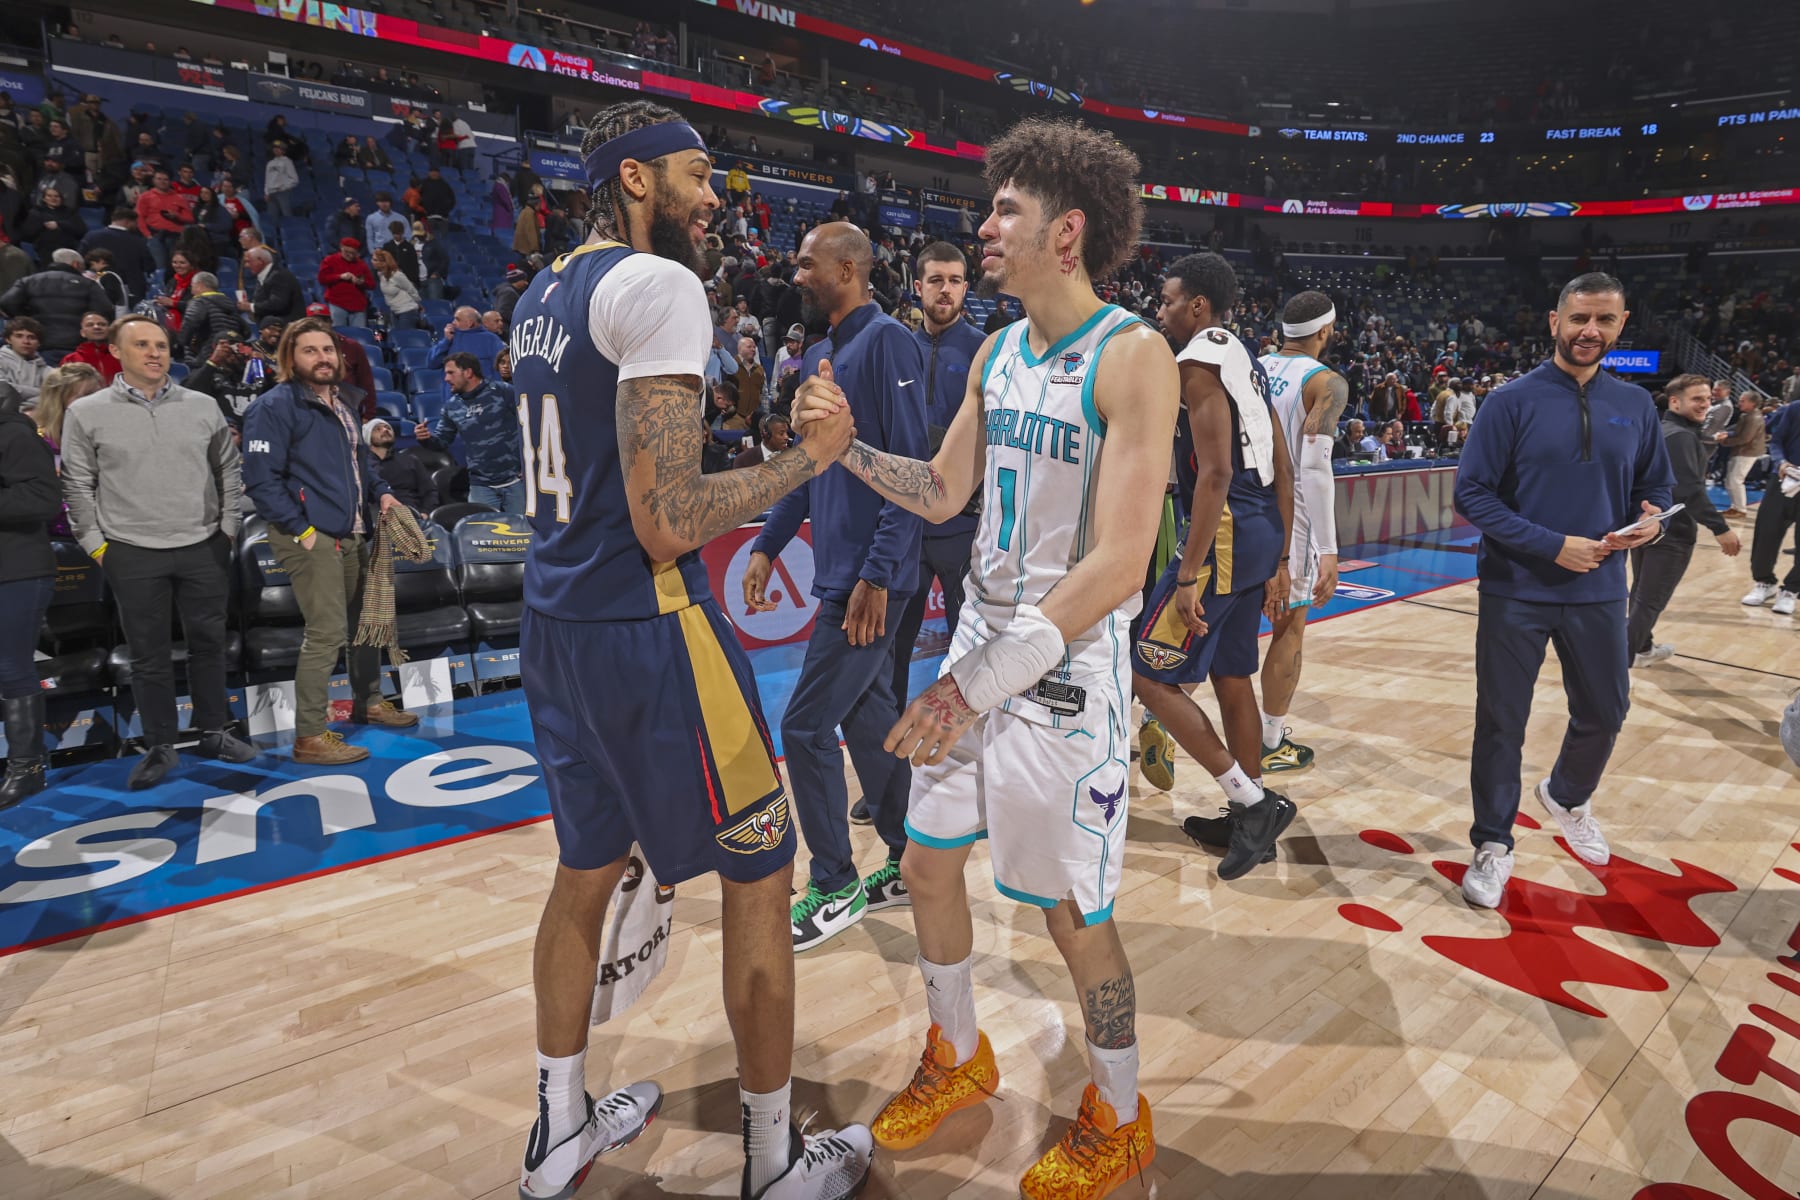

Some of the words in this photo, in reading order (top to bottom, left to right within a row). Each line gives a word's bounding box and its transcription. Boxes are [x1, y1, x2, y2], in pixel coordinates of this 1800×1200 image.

[253, 0, 378, 38] WIN!
[735, 0, 797, 28] WIN!
[553, 52, 588, 67] Aveda
[553, 64, 578, 77] Arts
[580, 70, 590, 80] &
[591, 71, 640, 90] Sciences
[299, 87, 340, 103] PELICANS
[340, 93, 365, 107] RADIO
[1717, 114, 1747, 127] PTS
[1749, 112, 1766, 124] IN
[1304, 129, 1332, 141] TEAM
[1333, 131, 1368, 142] STATS:
[1397, 134, 1417, 144] 2ND
[1418, 133, 1465, 144] CHANCE
[1480, 132, 1495, 143] 23
[1546, 129, 1576, 140] FAST
[1578, 126, 1622, 139] BREAK
[1641, 124, 1658, 135] 18
[762, 164, 834, 184] BETRIVERS
[1599, 356, 1652, 367] ANDUEL
[984, 407, 1081, 466] HARLOTTE
[516, 393, 574, 524] 14
[997, 466, 1018, 553] 1
[1333, 470, 1455, 547] WIN!
[471, 538, 530, 546] BETRIVERS
